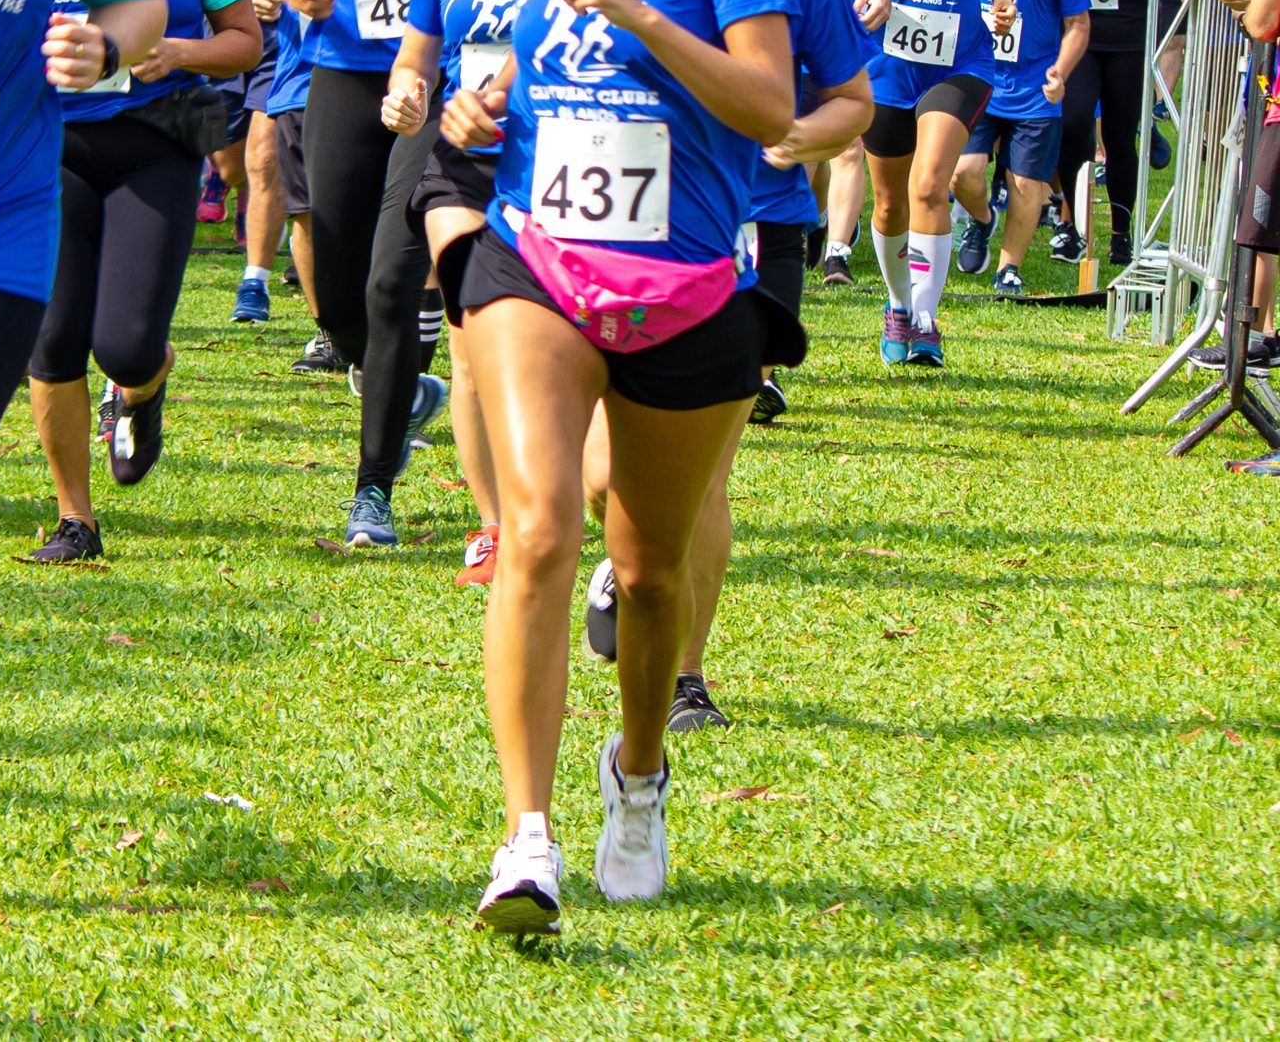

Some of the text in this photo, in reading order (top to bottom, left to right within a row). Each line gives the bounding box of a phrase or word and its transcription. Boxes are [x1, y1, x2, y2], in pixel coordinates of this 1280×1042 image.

[892, 25, 945, 57] 461
[596, 89, 660, 106] CLUBE
[540, 164, 657, 222] 437
